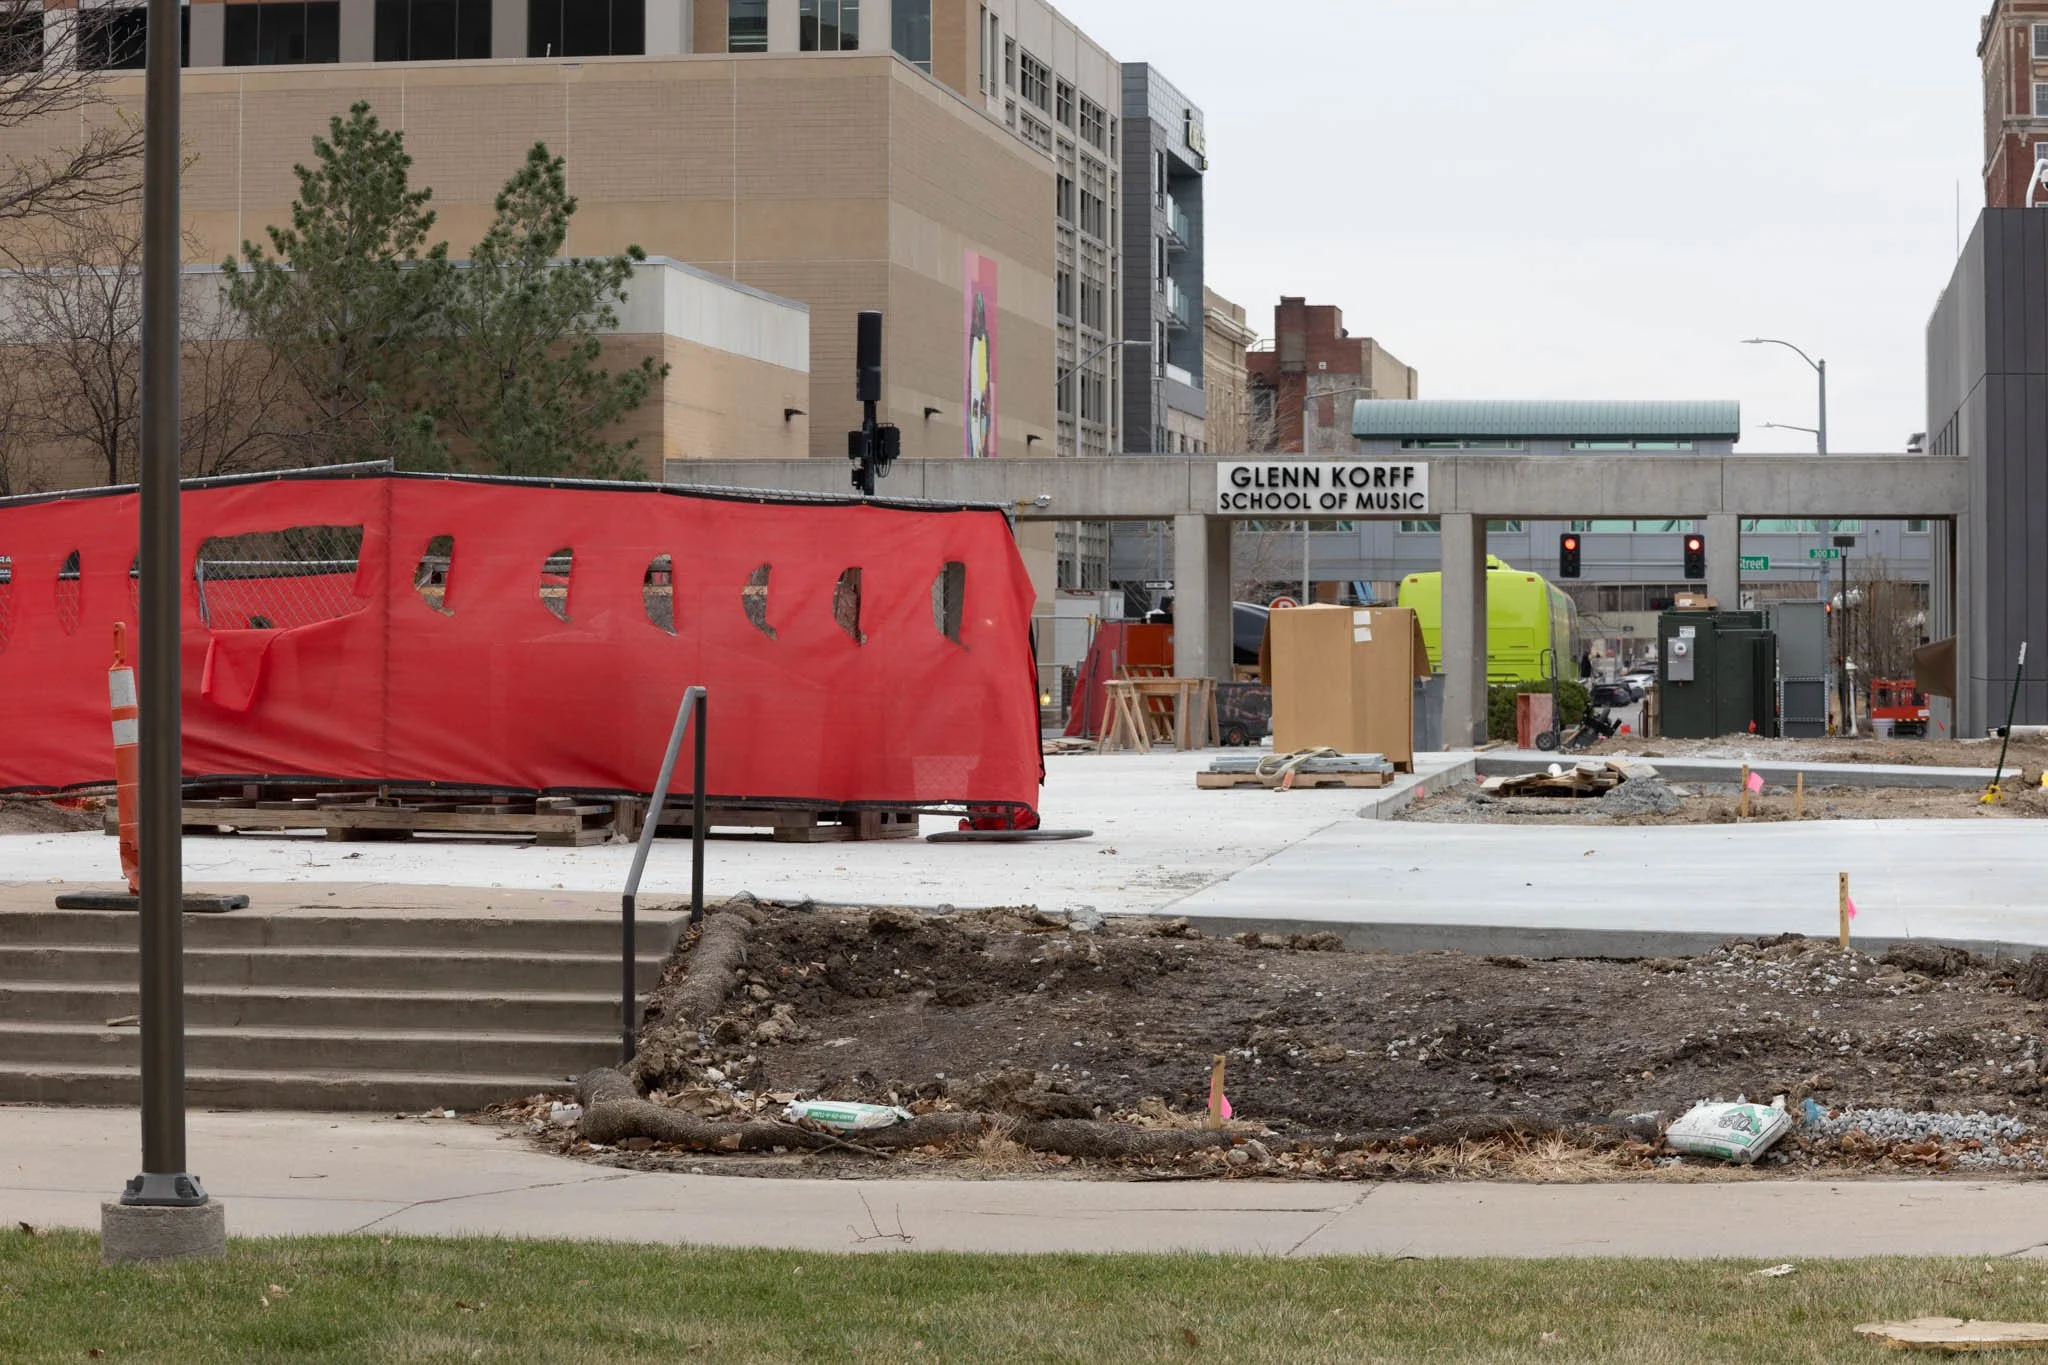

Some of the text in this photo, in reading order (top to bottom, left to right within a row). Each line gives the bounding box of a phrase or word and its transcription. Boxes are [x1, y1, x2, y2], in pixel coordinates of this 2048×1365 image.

[1231, 466, 1414, 488] GLENN KORFF
[1220, 492, 1425, 510] SCHOOL OF MUSIC
